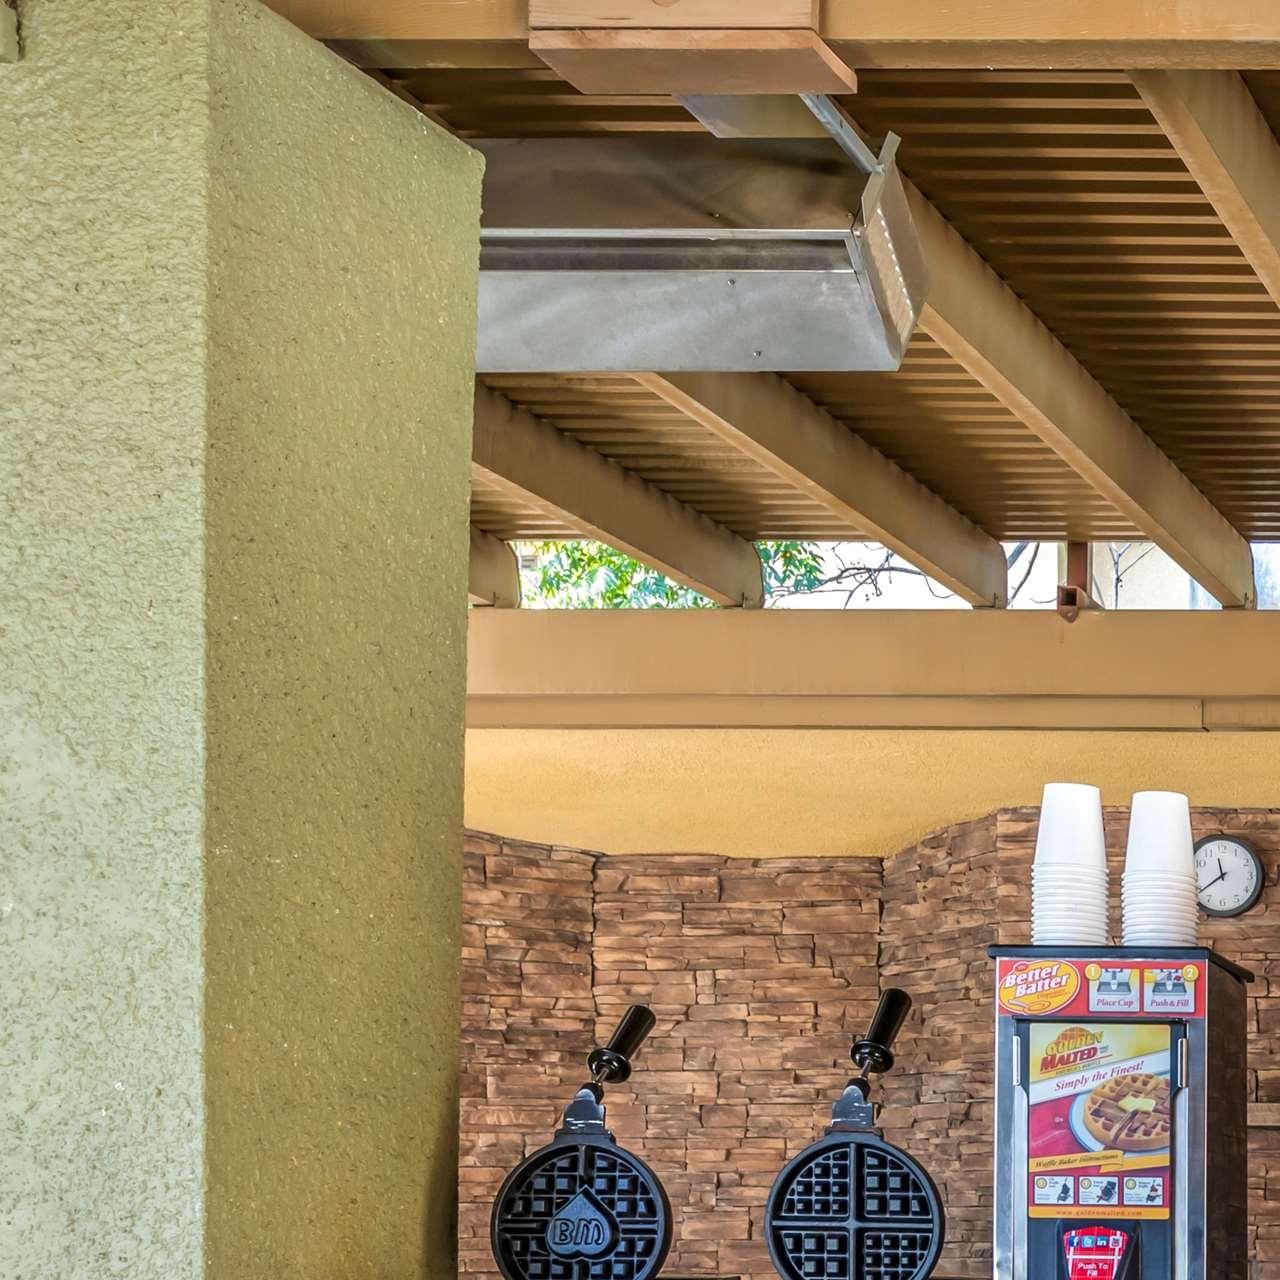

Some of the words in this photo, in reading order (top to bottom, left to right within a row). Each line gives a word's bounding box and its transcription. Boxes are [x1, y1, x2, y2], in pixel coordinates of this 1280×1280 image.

[1004, 964, 1061, 989] Better
[1015, 973, 1071, 999] Batter
[1096, 999, 1117, 1007] Place
[1117, 999, 1134, 1008] Cup
[1150, 999, 1169, 1007] Push
[1175, 999, 1190, 1007] Fill
[1040, 1046, 1099, 1072] MALTED
[1055, 1075, 1090, 1091] Simply
[1092, 1071, 1108, 1081] the
[1110, 1060, 1145, 1078] Finest!
[552, 1217, 605, 1246] BM
[1077, 1262, 1097, 1270] Push
[1099, 1262, 1109, 1270] To
[1087, 1269, 1098, 1277] Fill
